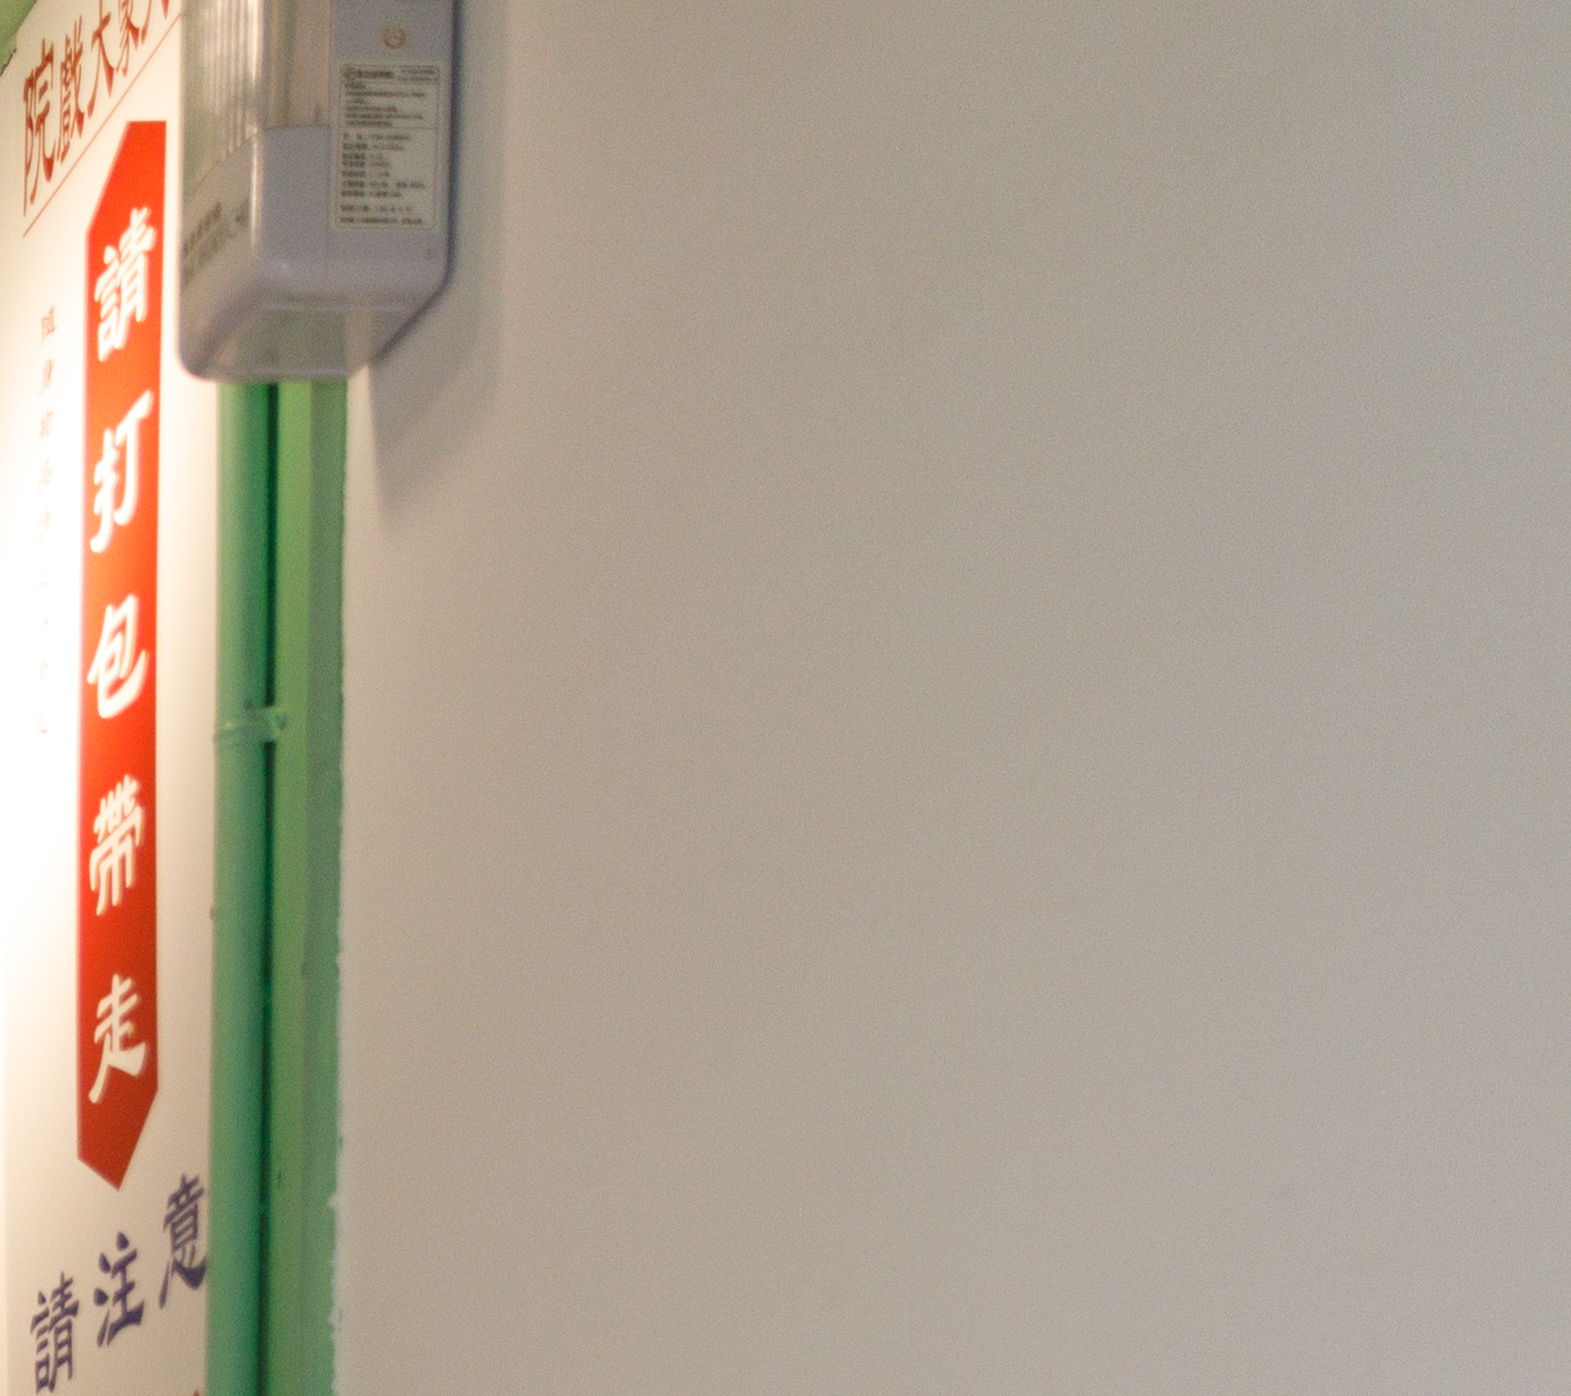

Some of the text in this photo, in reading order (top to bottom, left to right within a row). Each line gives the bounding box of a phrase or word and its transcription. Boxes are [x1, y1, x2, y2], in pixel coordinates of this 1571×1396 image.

[87, 205, 158, 1104] 請打包帶走
[31, 1173, 206, 1395] 請注意
